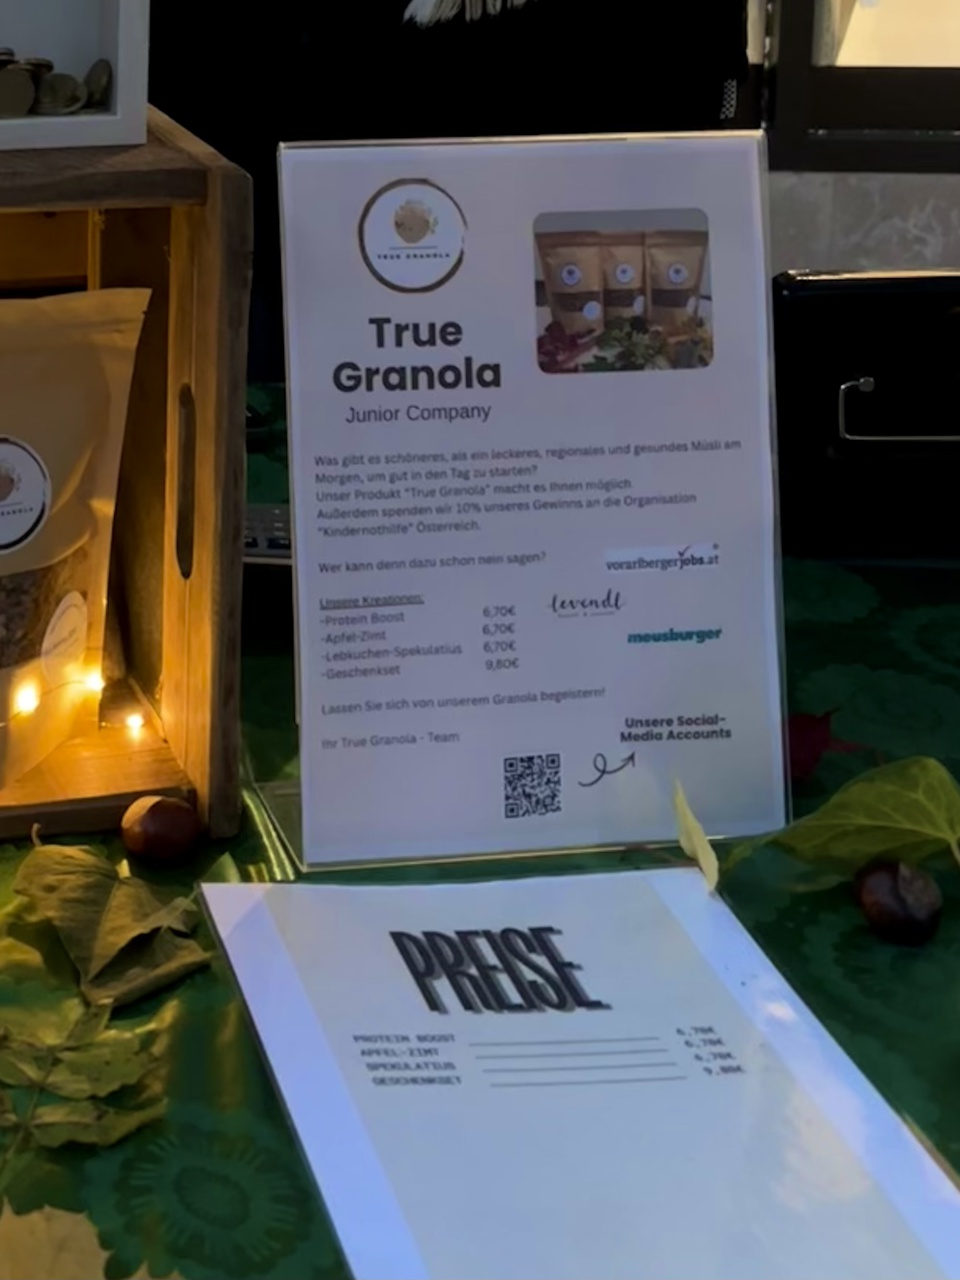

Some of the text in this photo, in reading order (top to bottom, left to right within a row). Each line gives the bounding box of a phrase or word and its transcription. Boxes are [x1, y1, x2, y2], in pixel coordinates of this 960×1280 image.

[368, 317, 463, 348] True
[333, 356, 501, 393] Granola
[345, 404, 491, 423] Junior Company
[314, 440, 741, 468] Was gibt es schöneres, als ein leckeres, regionales und gesundes Müsli am
[315, 466, 538, 485] Morgen, um gut in den Tag zu starten?
[316, 490, 350, 502] Unser
[354, 489, 401, 500] Produkt
[493, 484, 530, 494] macht
[533, 483, 546, 492] es
[549, 481, 583, 491] Ihnen
[317, 493, 697, 520] Außerdem spenden wir 10% unseres Gewinns an die Organisation
[416, 520, 480, 533] Österreich.
[318, 551, 546, 574] Wer kann denn dazu schon nein sagen?
[319, 596, 359, 609] Unsere
[371, 612, 405, 624] Boost
[483, 605, 516, 618] 6,70€
[482, 623, 515, 636] 6,70€
[483, 641, 517, 654] 6,70€
[485, 658, 520, 671] 9,80€
[321, 703, 362, 715] Lassen
[365, 700, 383, 712] Sie
[386, 698, 409, 711] sich
[413, 699, 435, 709] von
[438, 696, 490, 708] unserem
[493, 692, 538, 705] Granola
[625, 713, 726, 729] Unsere Social-
[321, 738, 337, 750] Ihr
[341, 735, 367, 748] True
[370, 733, 417, 746] Granola
[427, 731, 460, 743] Team
[620, 728, 732, 742] Media Accounts
[389, 926, 613, 1015] PREISE
